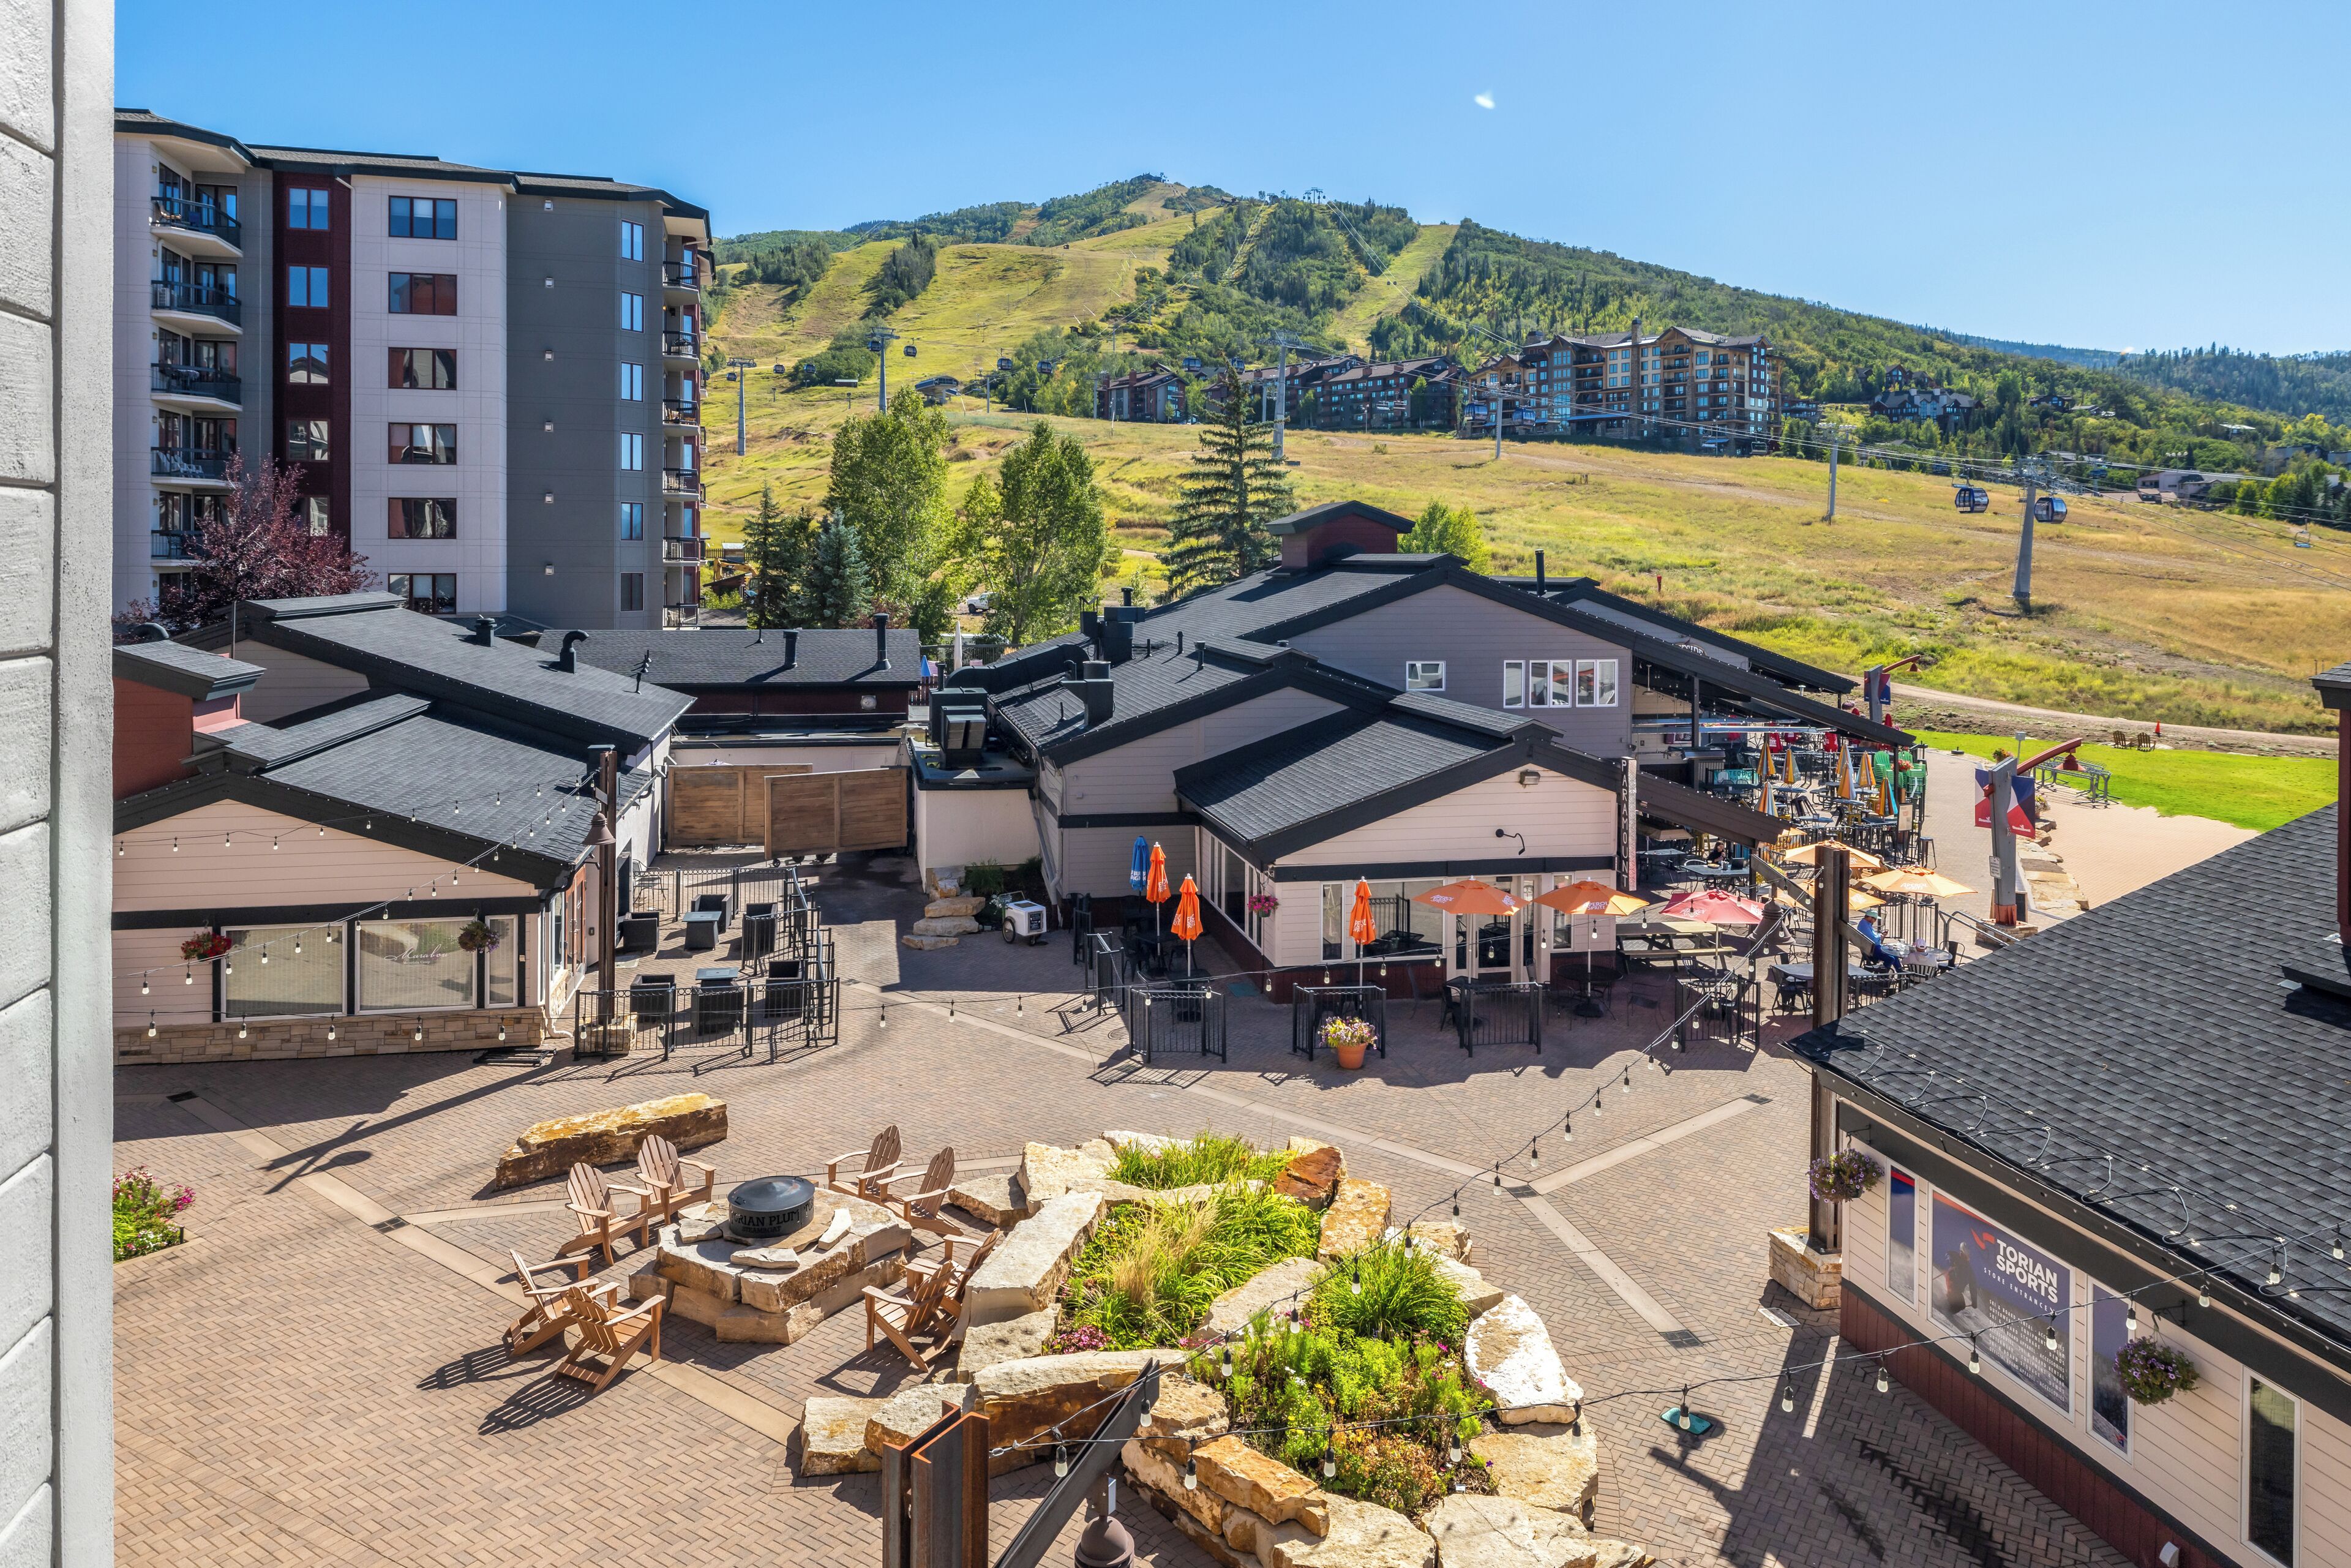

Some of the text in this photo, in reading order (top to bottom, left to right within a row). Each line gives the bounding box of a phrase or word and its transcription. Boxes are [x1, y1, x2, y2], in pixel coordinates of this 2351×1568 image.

[384, 943, 449, 961] Marabou
[769, 1209, 800, 1226] PLUM
[1996, 1255, 2058, 1304] SPORTS
[1997, 1239, 2057, 1289] TORIAN
[1984, 1267, 2047, 1311] STORE ENTRANCE
[1989, 1306, 2013, 1325] OUTERWEAR
[2021, 1327, 2045, 1346] EQUIPMENT
[1989, 1319, 2064, 1373] OFFIAL BRAND APPAREL ACCESSORIES
[2003, 1308, 2015, 1319] BOARD
[2038, 1331, 2064, 1351] ACCIES
[2004, 1349, 2018, 1362] BOARD
[2020, 1333, 2040, 1349] STORAGE
[2049, 1352, 2064, 1365] DEMOS
[2007, 1358, 2019, 1370] BRAND
[2040, 1381, 2064, 1401] ACCESSORIES
[2049, 1366, 2064, 1380] RENTAL
